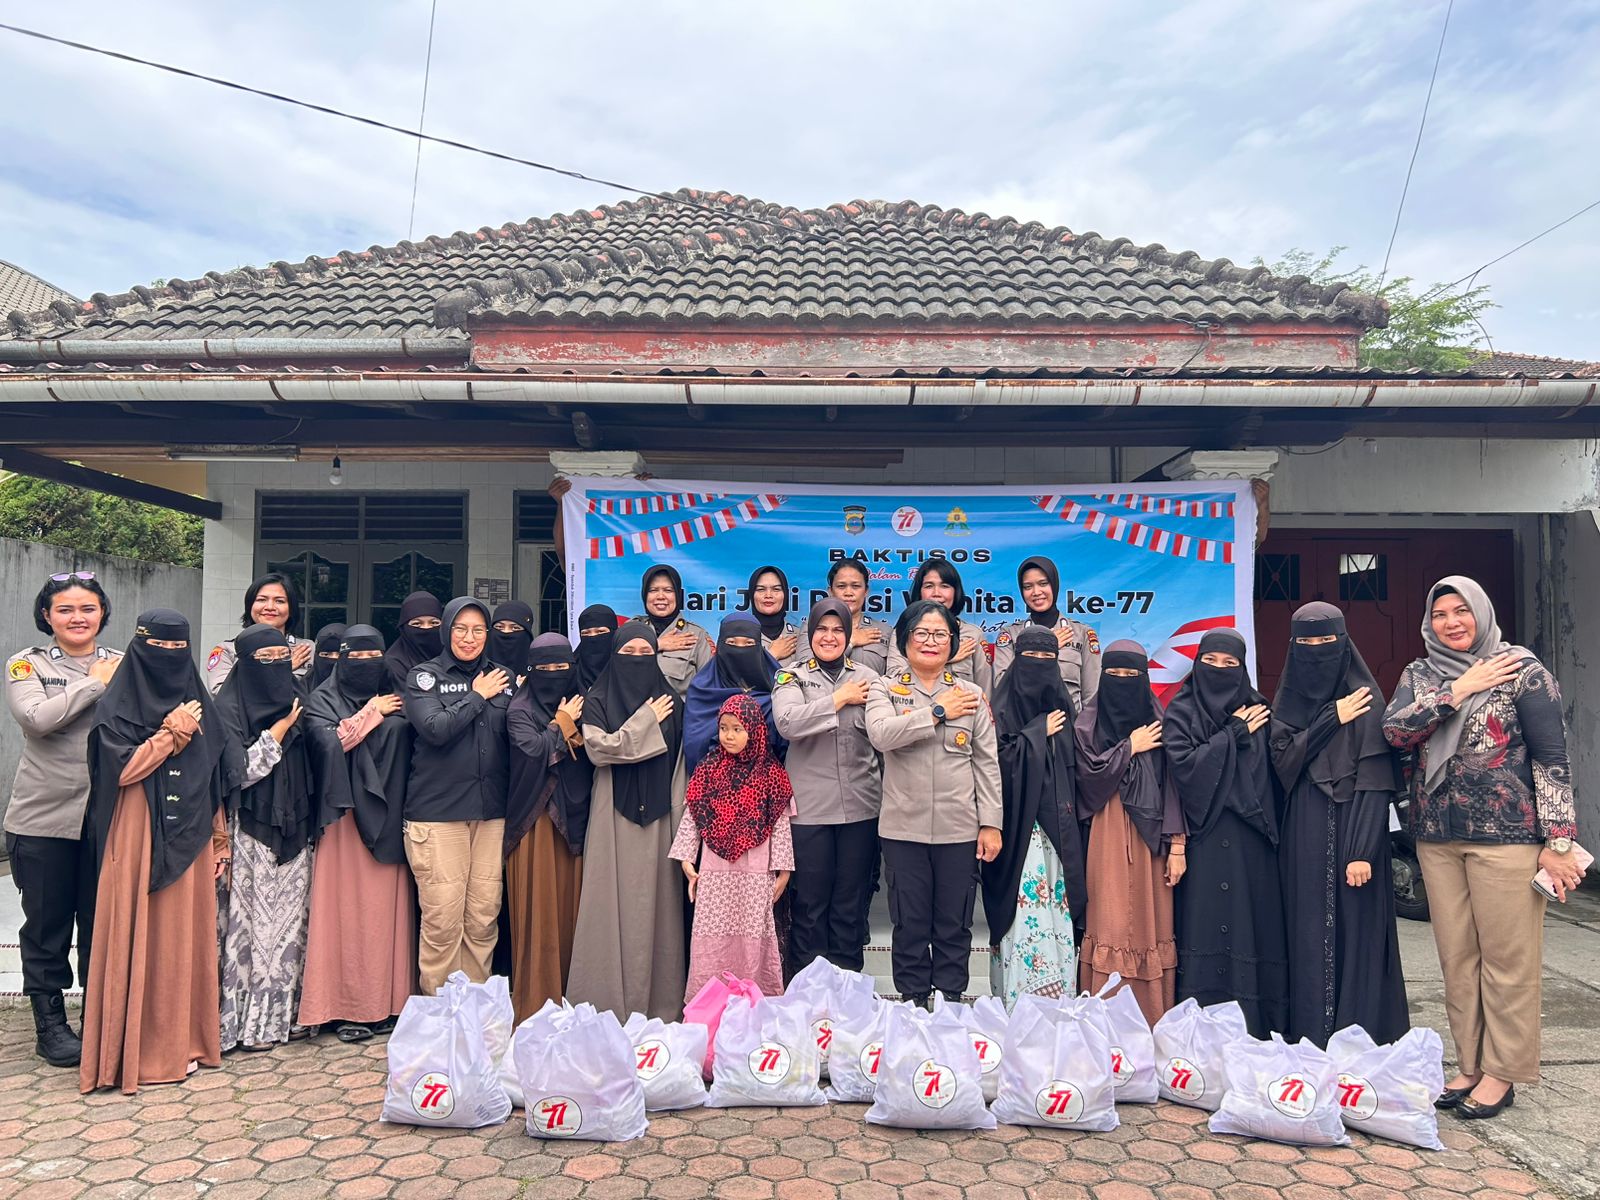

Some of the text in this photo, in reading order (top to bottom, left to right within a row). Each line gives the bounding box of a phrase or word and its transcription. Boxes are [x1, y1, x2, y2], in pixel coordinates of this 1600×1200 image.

[897, 510, 916, 529] 77
[829, 549, 991, 562] BAKTISOS
[1067, 591, 1154, 614] ke-77
[440, 683, 467, 693] NOFI
[637, 1045, 660, 1070] 77
[759, 1048, 781, 1072] 77
[869, 1047, 884, 1074] 7
[1171, 1067, 1193, 1089] 77
[420, 1082, 449, 1108] 77
[1045, 1089, 1072, 1115] 77
[1279, 1079, 1304, 1102] 77
[1338, 1083, 1365, 1107] 77
[542, 1101, 569, 1129] 77
